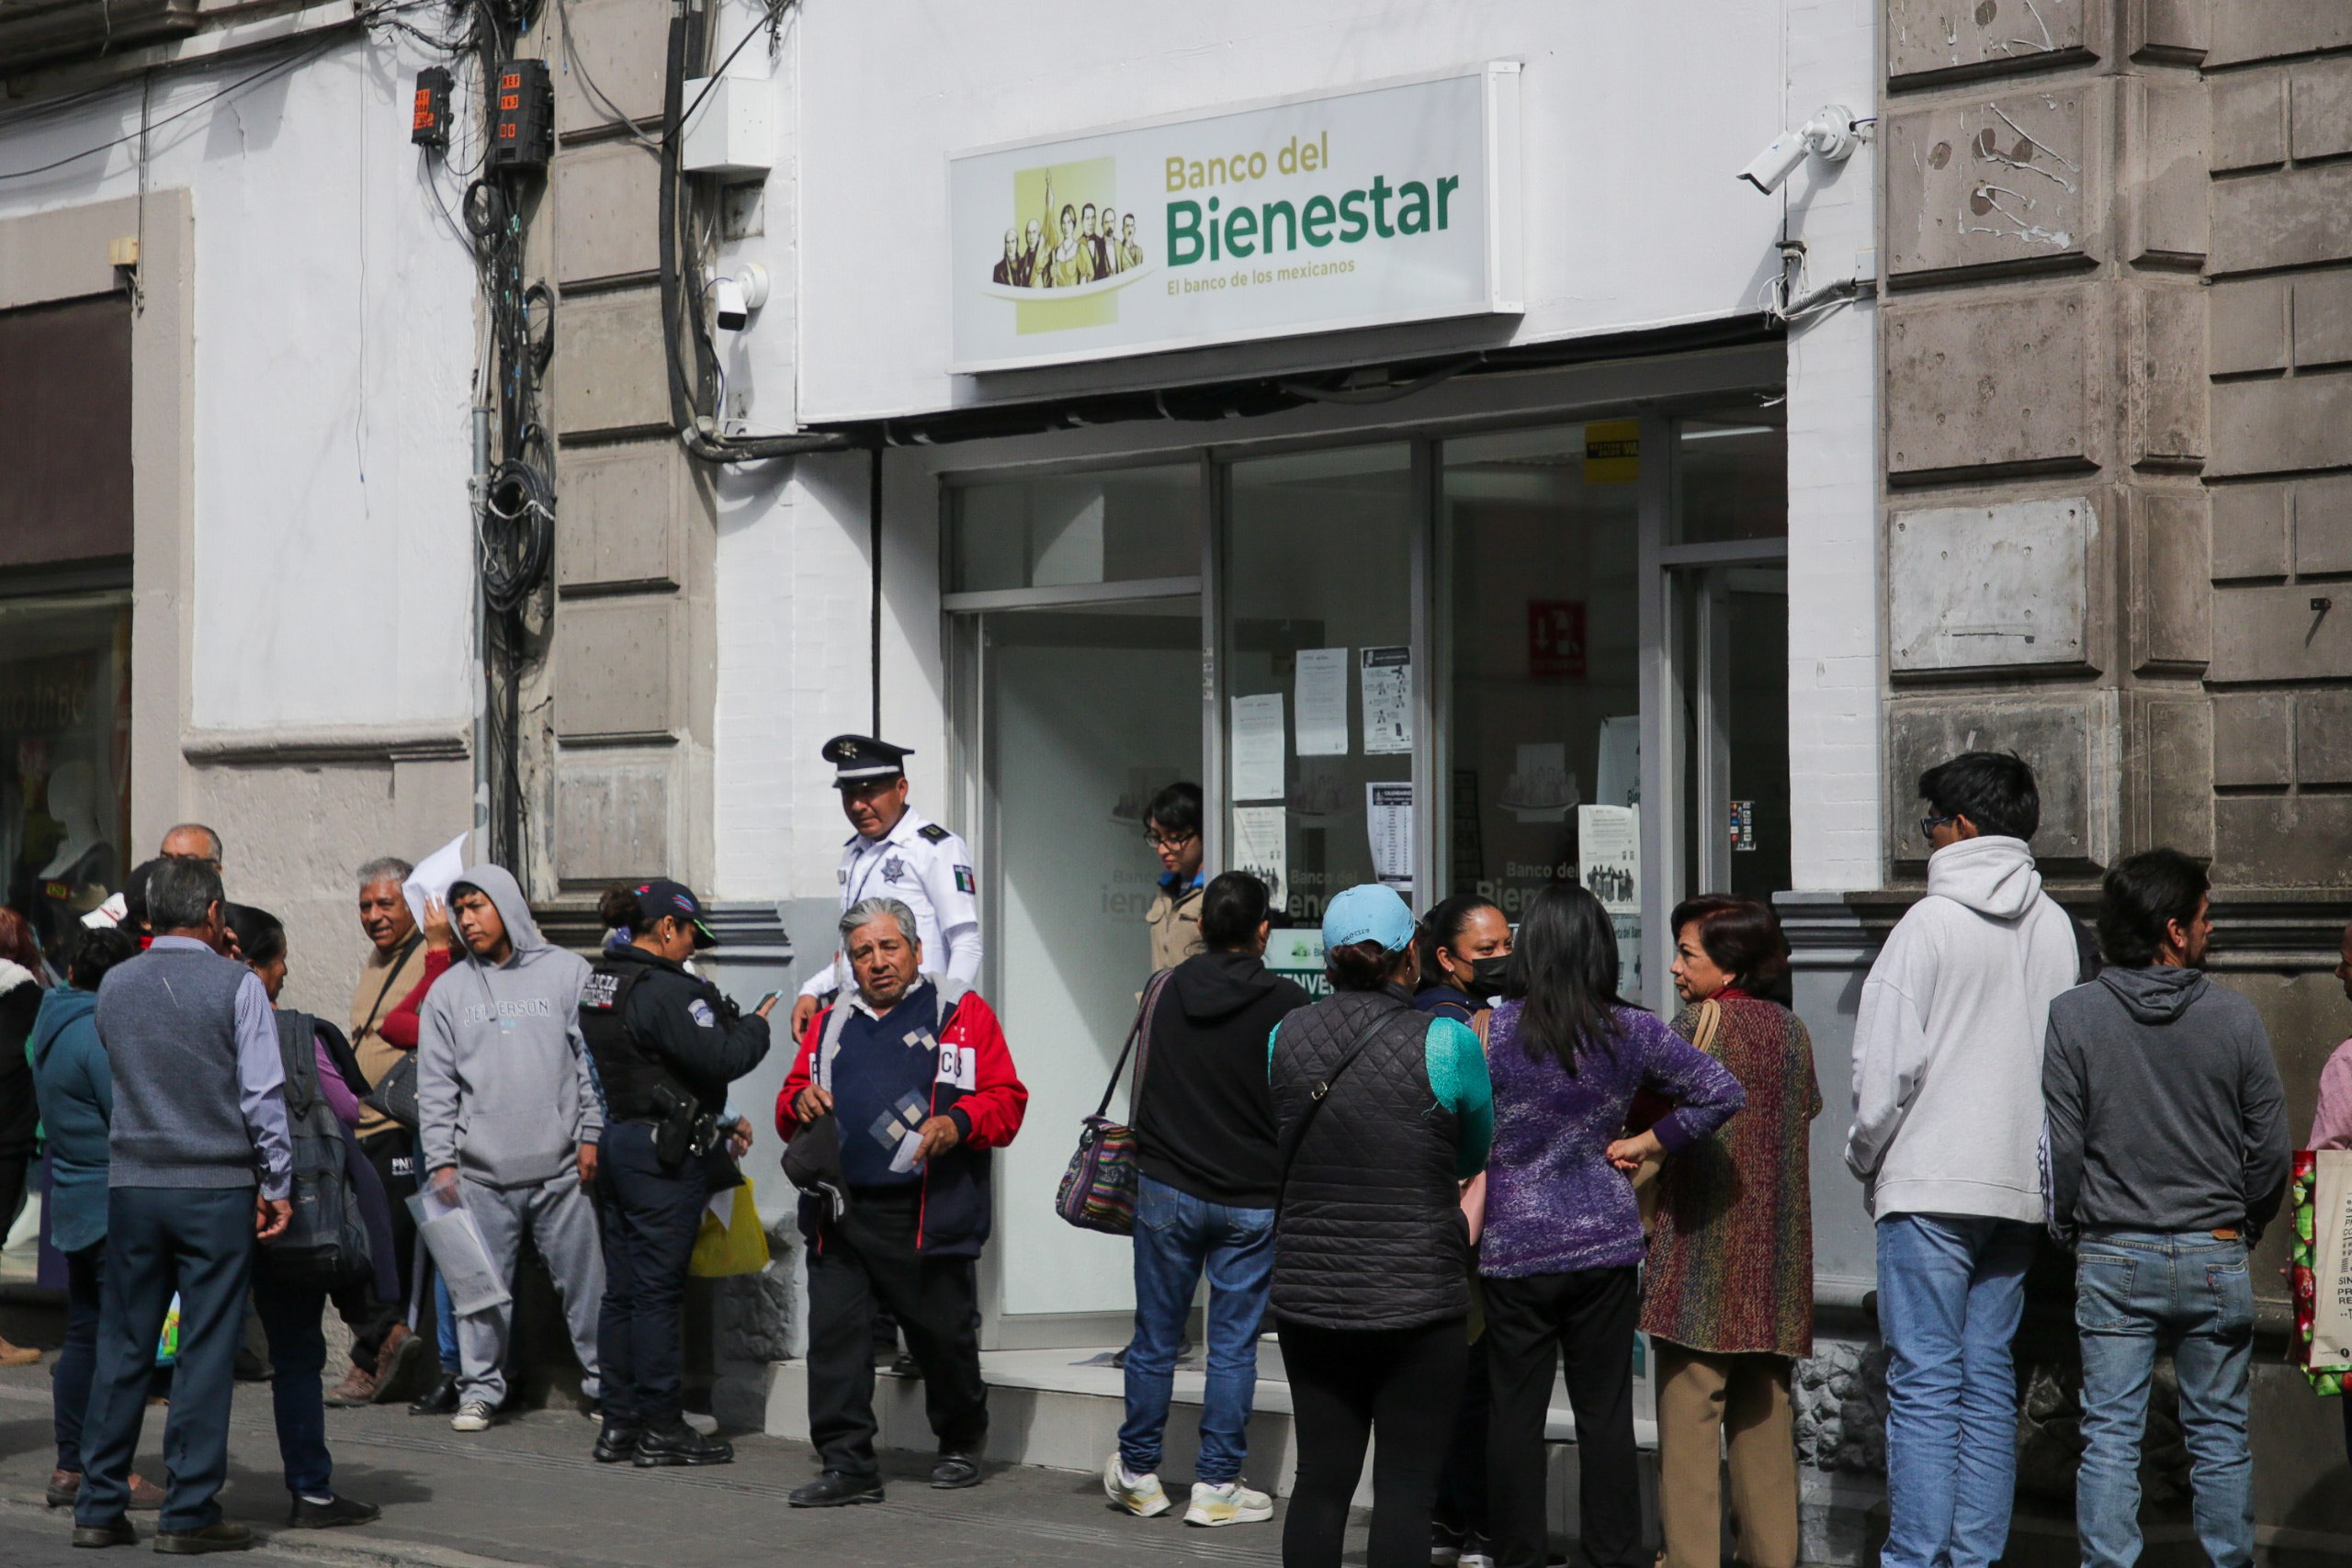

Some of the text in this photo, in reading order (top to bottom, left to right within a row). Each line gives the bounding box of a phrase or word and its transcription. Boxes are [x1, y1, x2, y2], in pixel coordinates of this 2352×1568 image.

[503, 75, 519, 87] REF
[503, 96, 517, 107] 163
[1166, 131, 1329, 192] Banco del
[1167, 175, 1459, 267] Bienestar
[1168, 260, 1355, 295] El banco de los mexicanos
[1291, 869, 1332, 884] Banco
[1506, 861, 1579, 879] Banco del
[464, 998, 550, 1027] JEERSON
